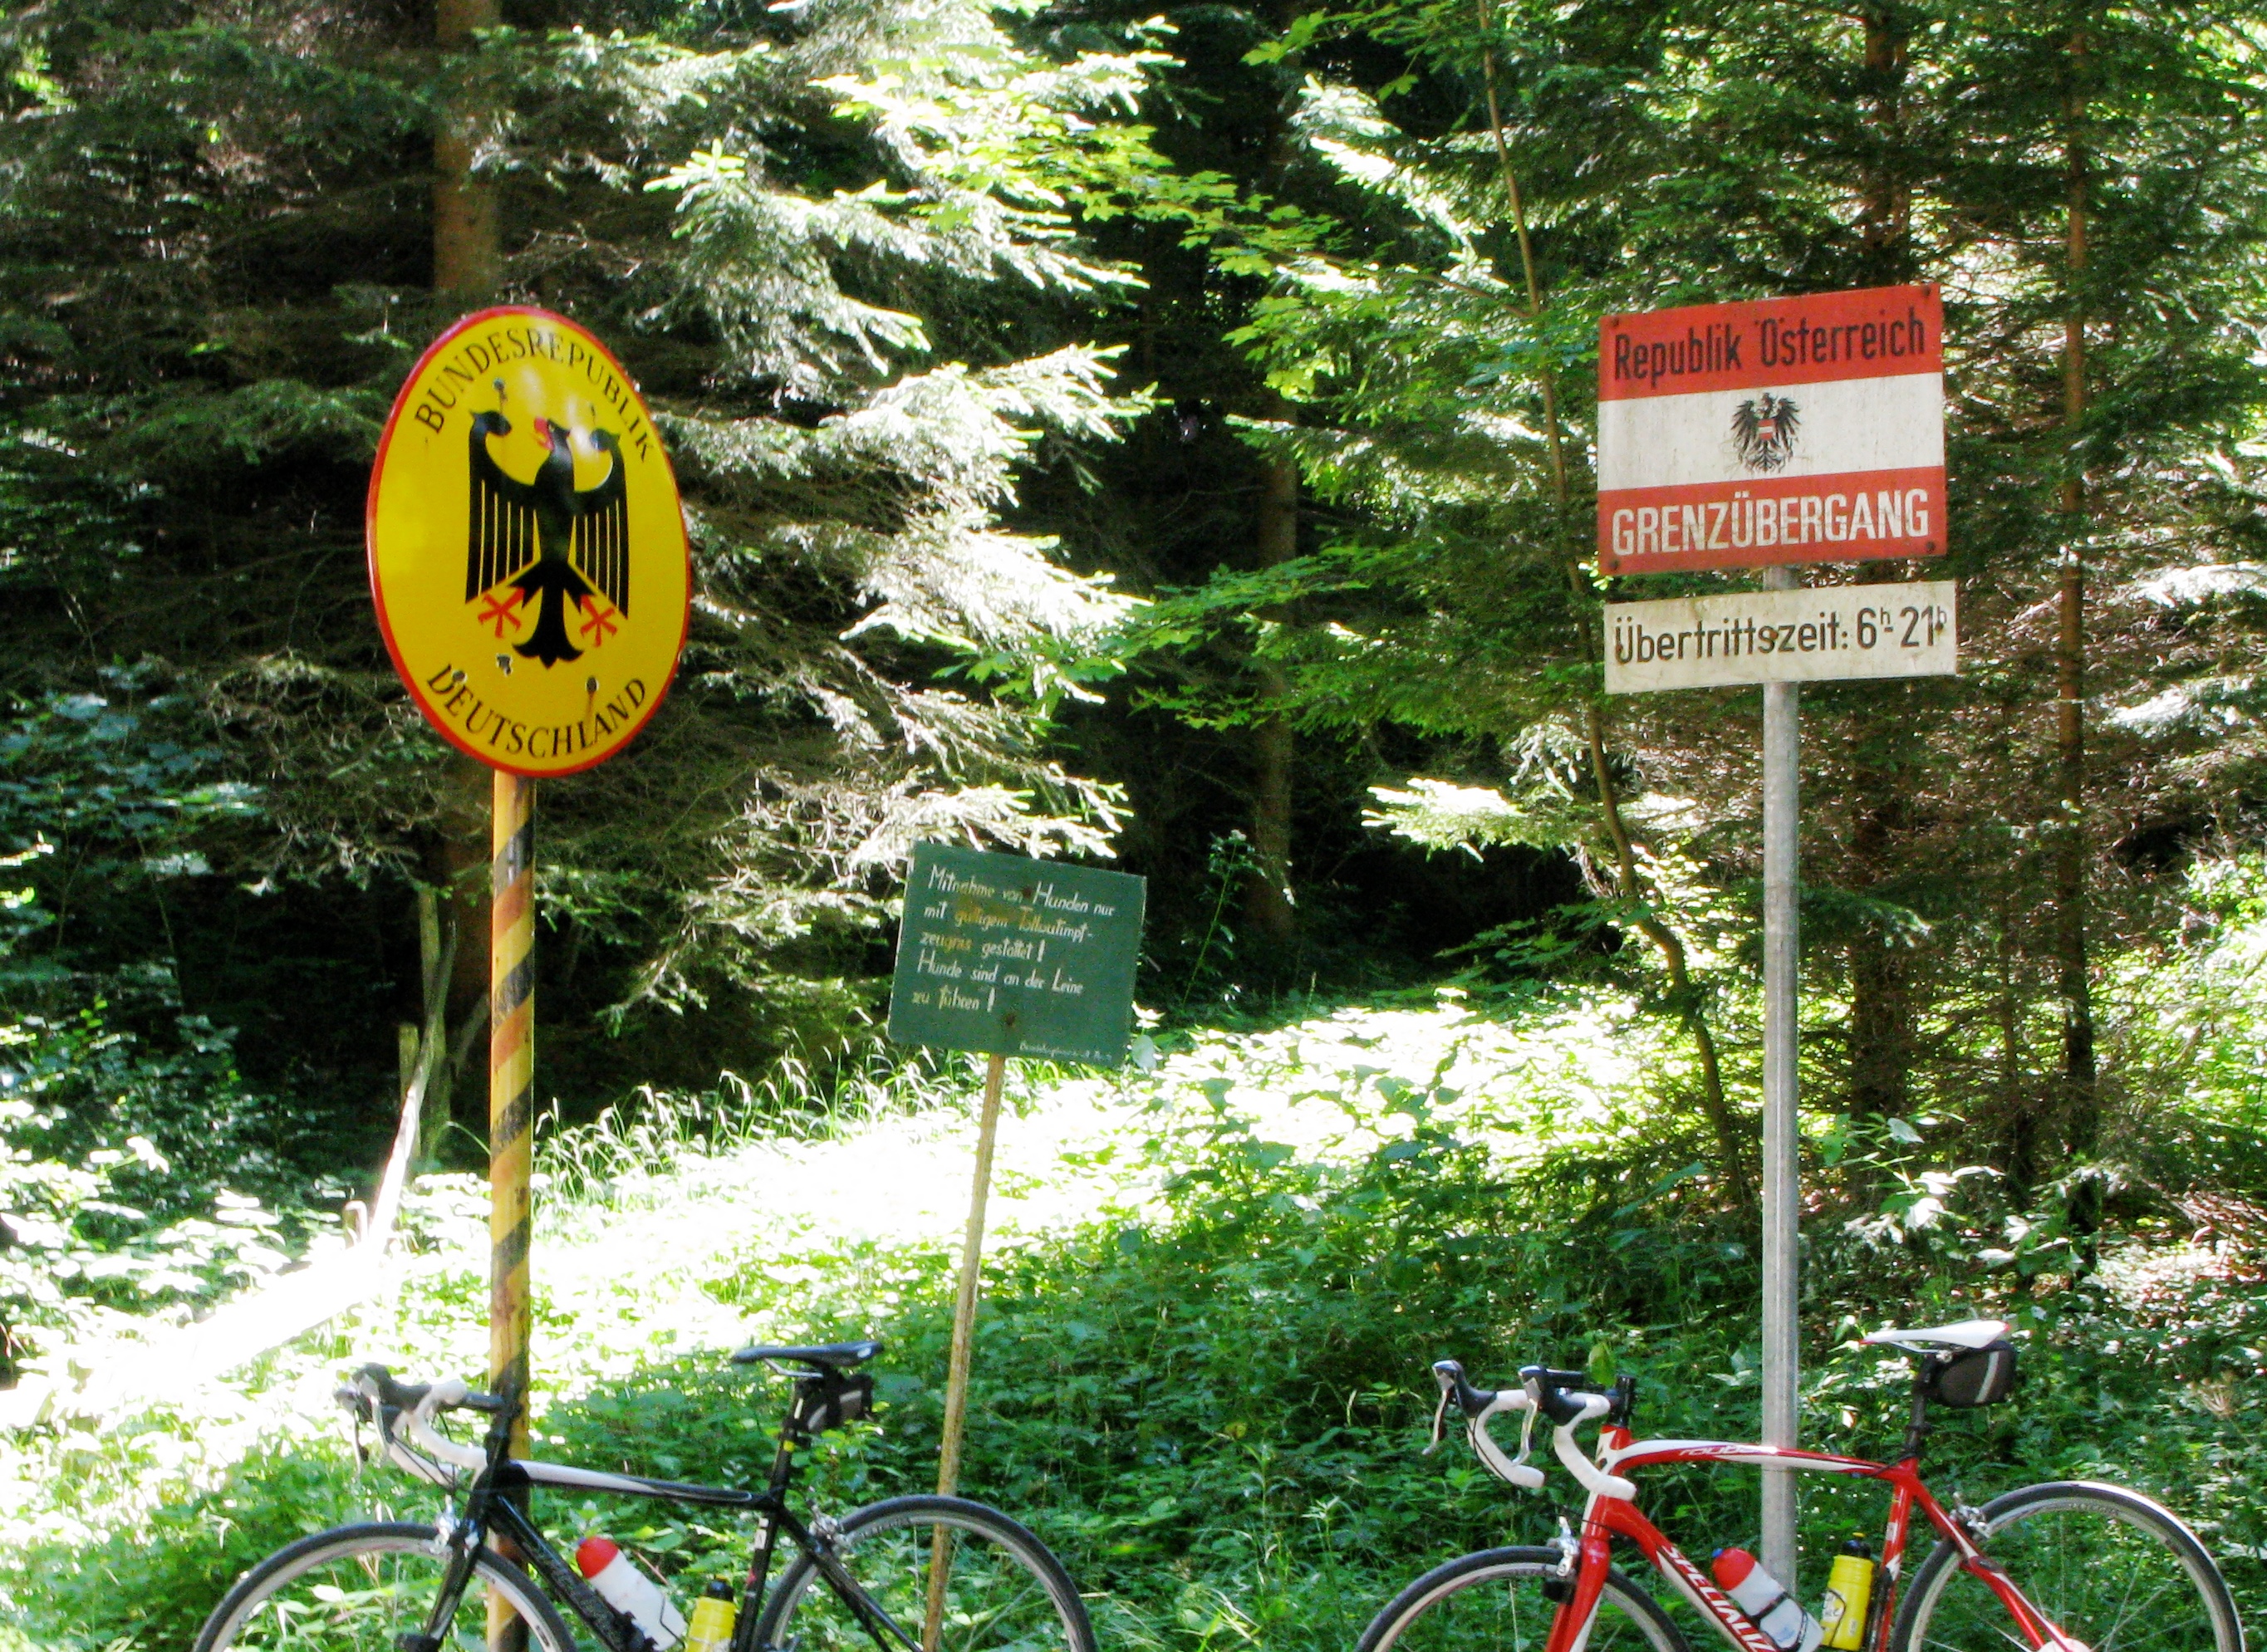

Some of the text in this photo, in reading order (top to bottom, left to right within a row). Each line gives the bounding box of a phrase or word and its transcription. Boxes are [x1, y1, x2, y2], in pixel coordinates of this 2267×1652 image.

[1614, 306, 1926, 388] Republik Österreich
[415, 327, 651, 463] BUNDESREPUBLIK
[1612, 488, 1930, 557] GRENZÜBERGANG
[1615, 611, 1848, 664] Übertrittszeit:
[426, 663, 646, 758] DEUTSCHLAND
[924, 900, 948, 919] mit
[928, 864, 1116, 916] Mitnahme von Hunden nur
[917, 948, 1084, 995] Hunde sind an der Leine
